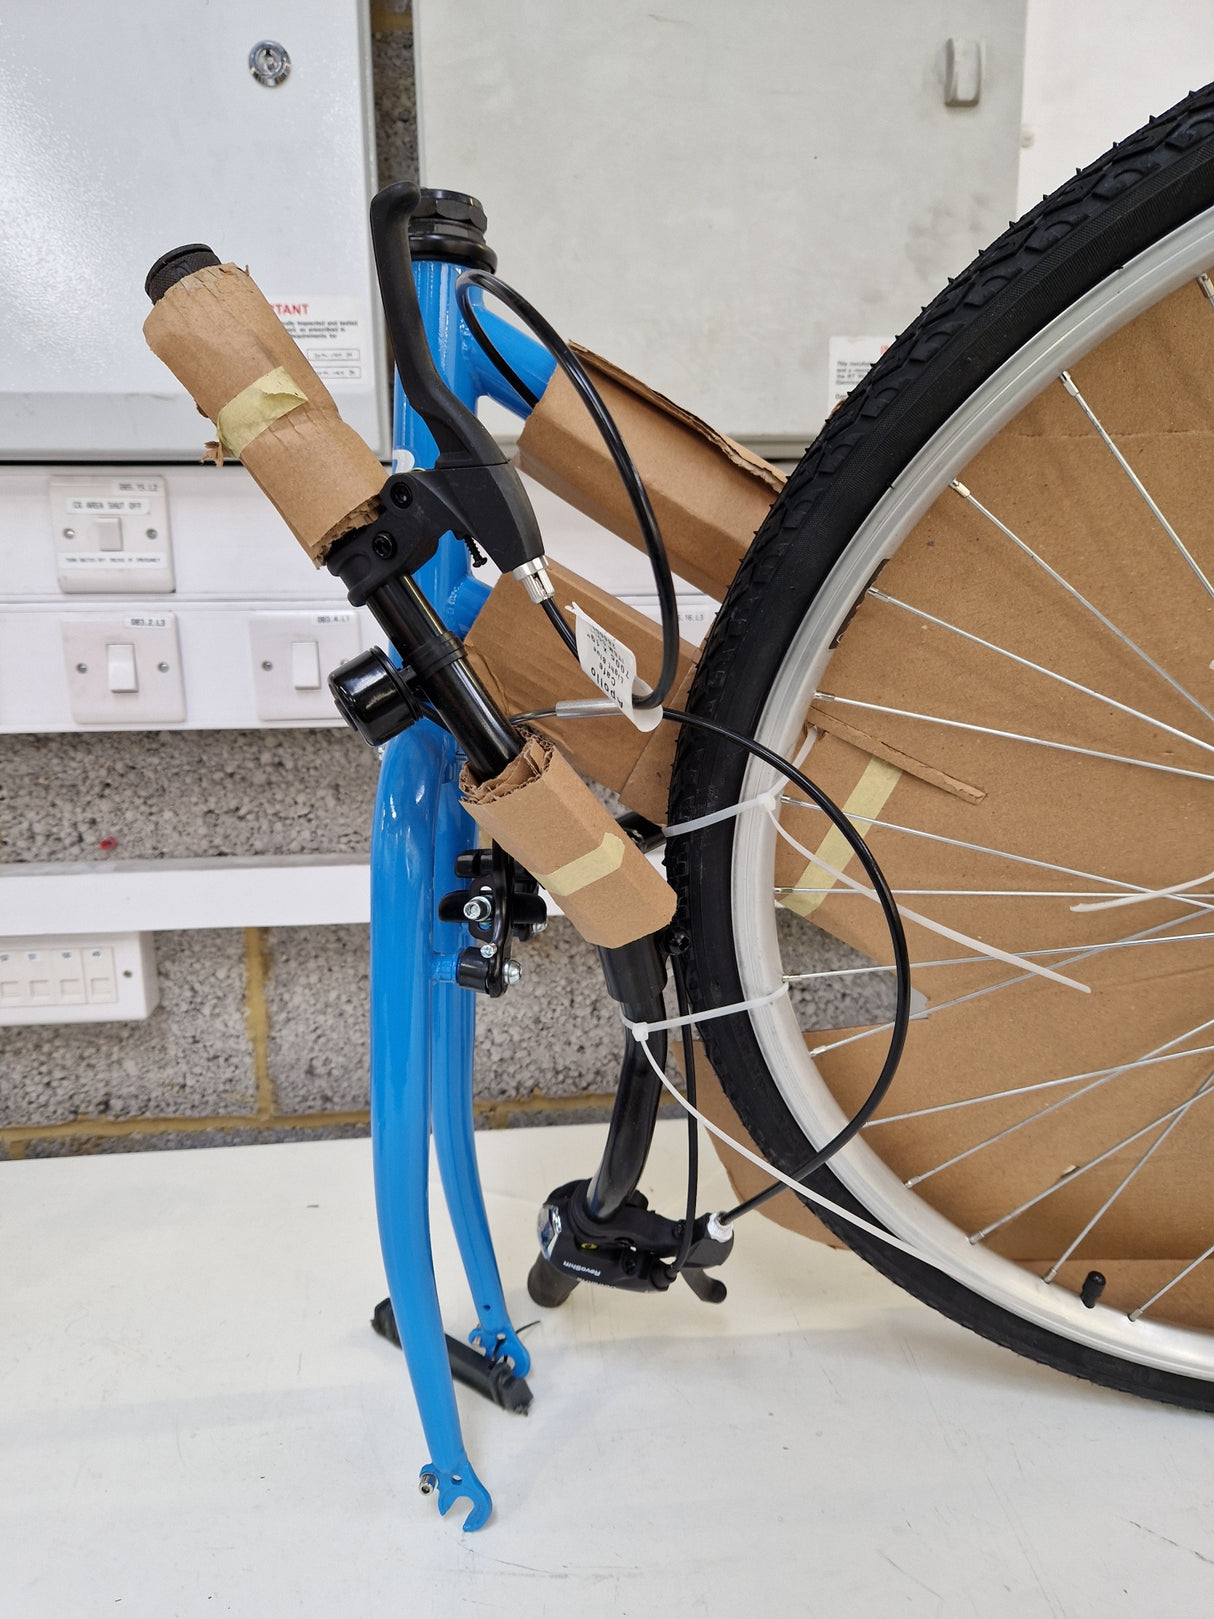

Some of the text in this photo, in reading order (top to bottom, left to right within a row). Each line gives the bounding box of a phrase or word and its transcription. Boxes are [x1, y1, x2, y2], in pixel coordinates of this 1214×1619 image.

[593, 646, 607, 664] Blue
[599, 662, 616, 687] Cafe
[608, 661, 624, 685] Light
[590, 667, 624, 709] Apollo
[562, 1260, 602, 1277] RevoShift
